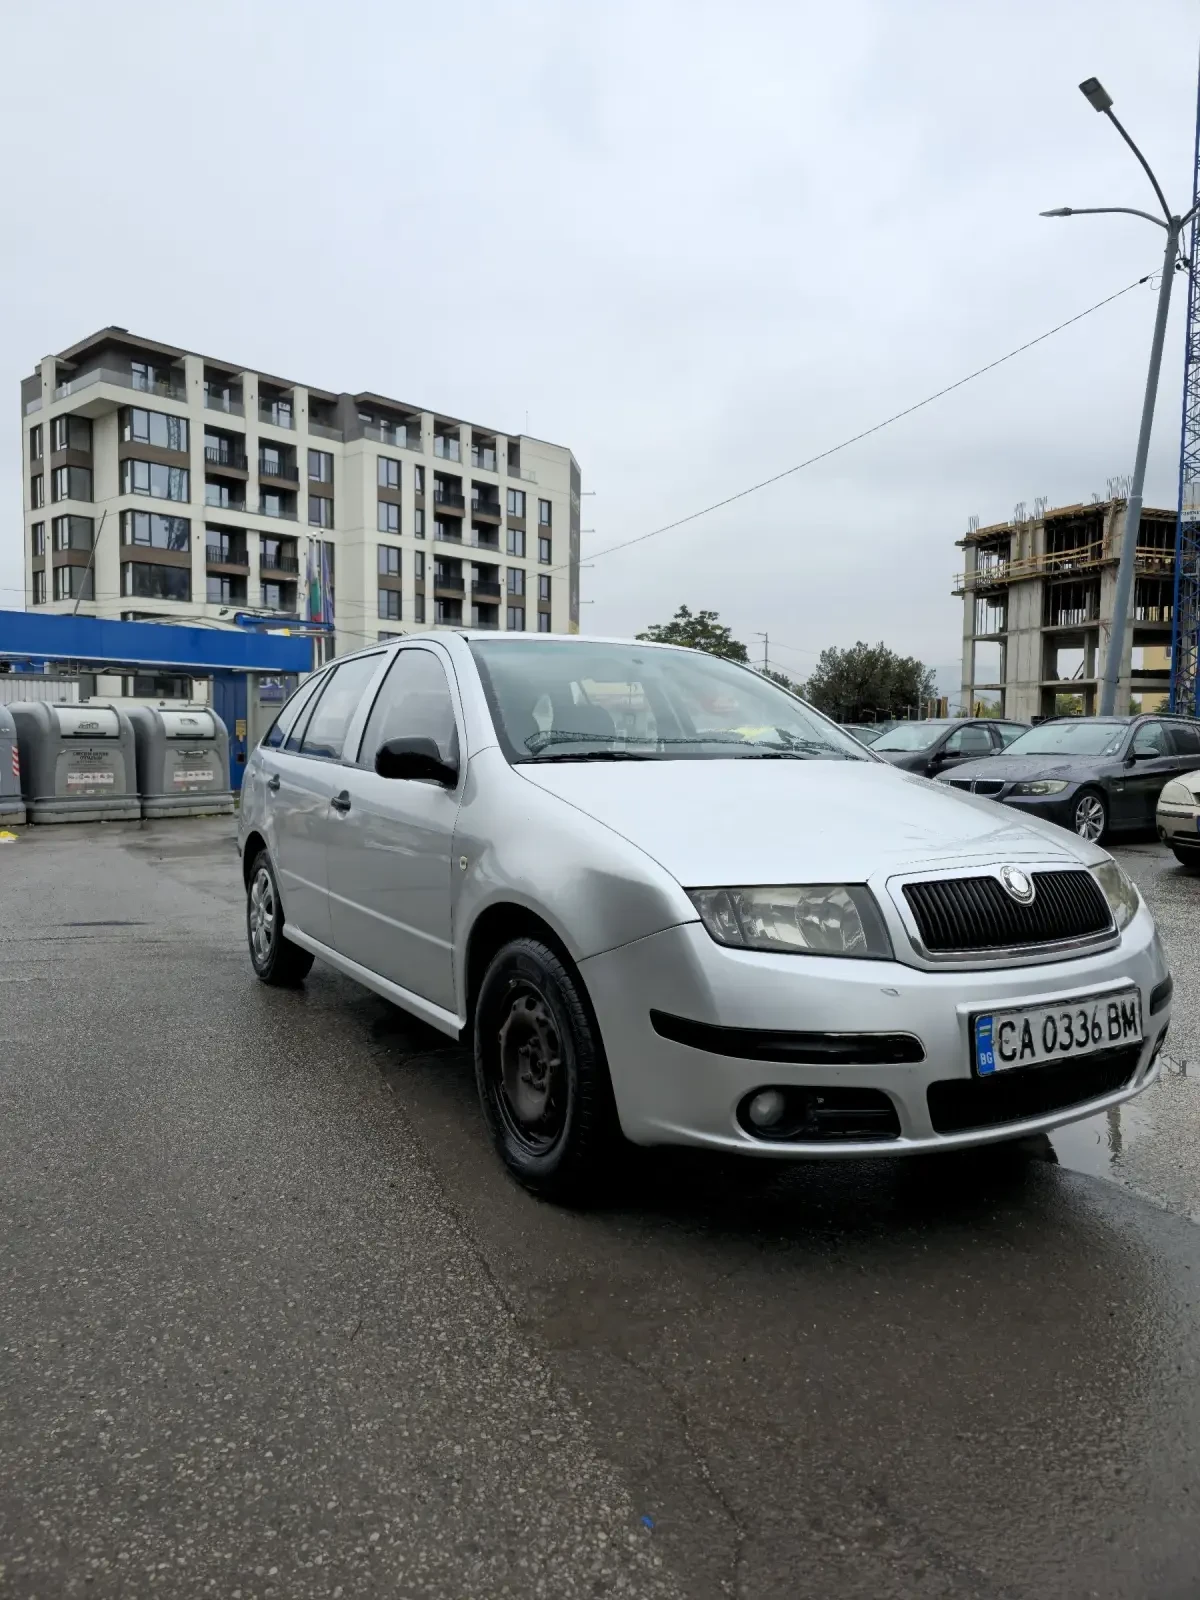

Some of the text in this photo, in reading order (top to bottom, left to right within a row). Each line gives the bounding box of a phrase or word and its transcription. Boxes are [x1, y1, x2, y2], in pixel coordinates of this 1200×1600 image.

[998, 1000, 1138, 1062] CA 0336 BM
[980, 1052, 993, 1065] BG
